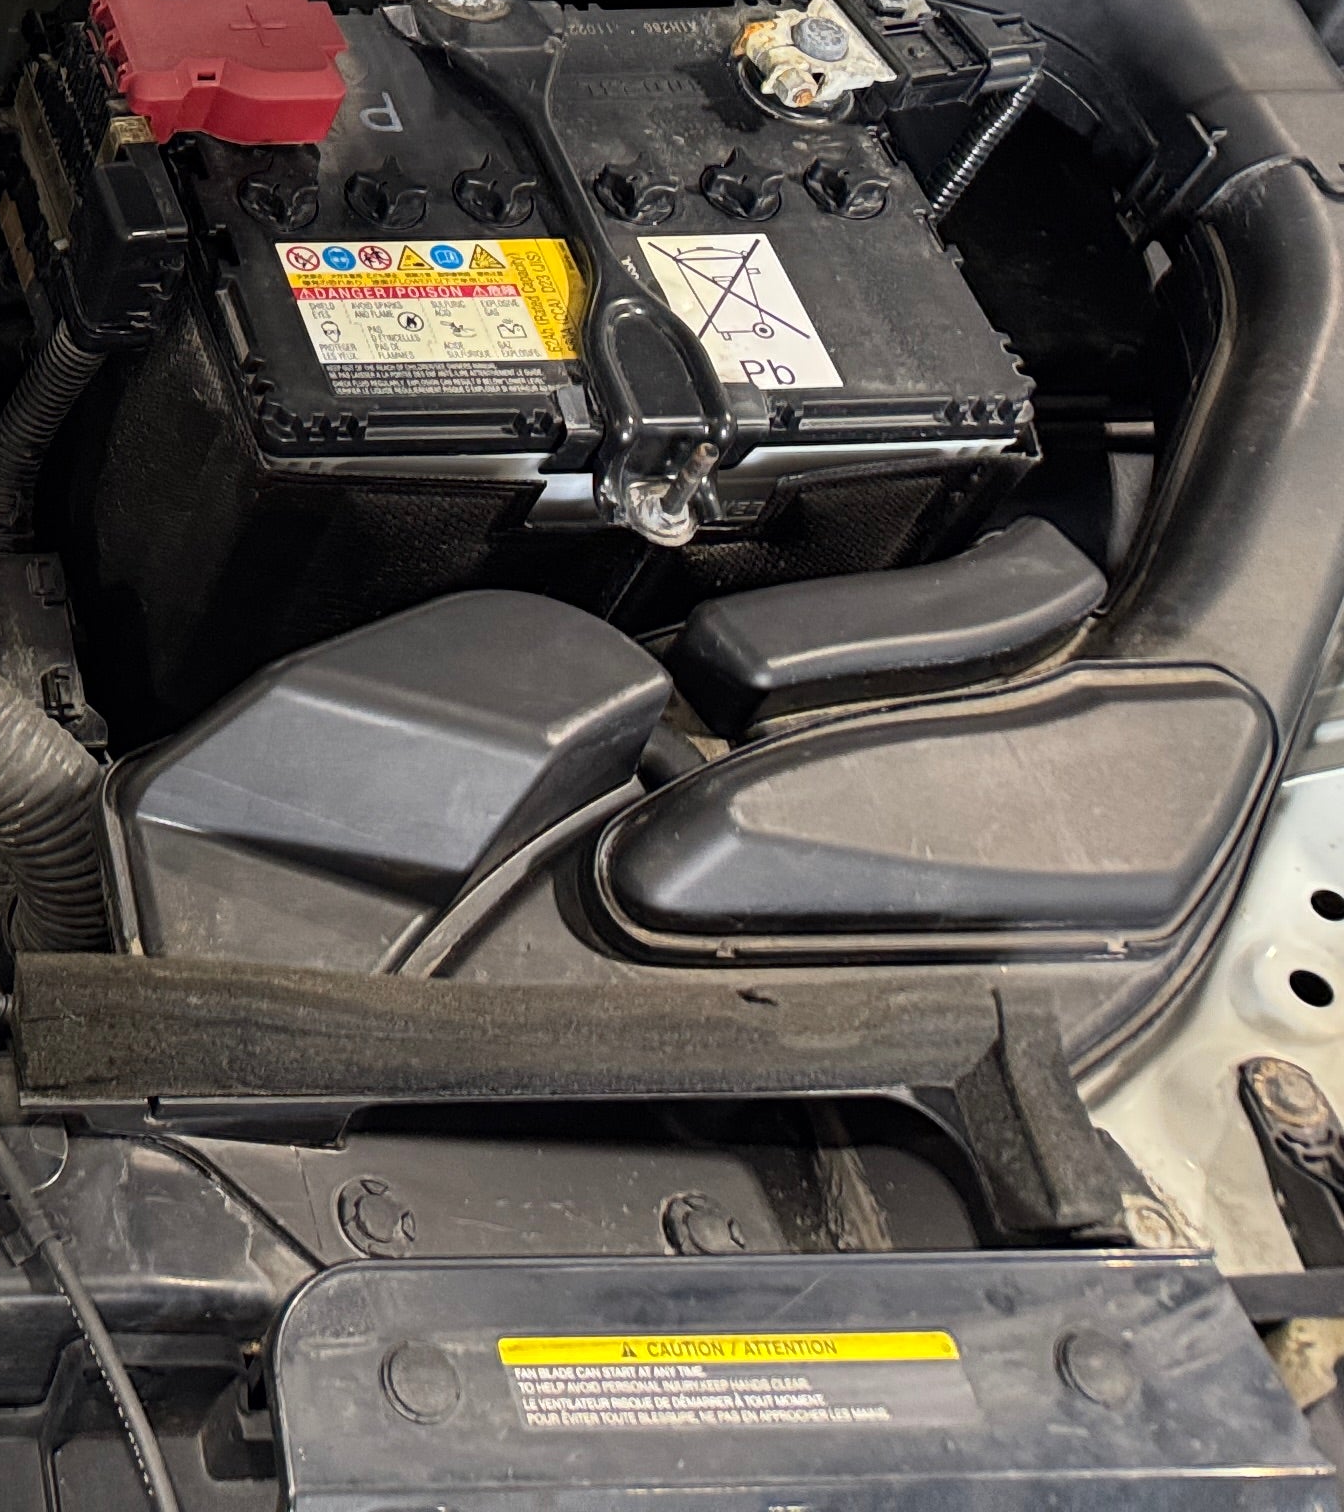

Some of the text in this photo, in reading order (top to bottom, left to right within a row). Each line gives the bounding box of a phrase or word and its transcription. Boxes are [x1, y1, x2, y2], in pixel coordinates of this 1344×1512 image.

[740, 359, 796, 385] Pb
[646, 1340, 724, 1359] CAUTION
[743, 1338, 838, 1356] ATTENTION
[514, 1368, 538, 1379] FAN
[538, 1367, 574, 1379] BLADE
[575, 1366, 602, 1378] CAN
[602, 1366, 636, 1378] START
[638, 1366, 652, 1377] AT
[653, 1365, 676, 1377] ANY
[518, 1382, 535, 1394] TO
[537, 1381, 565, 1393] HELP
[567, 1381, 601, 1393] AVOID
[602, 1380, 661, 1393] PERSONAL
[522, 1398, 538, 1410] LE
[539, 1397, 611, 1410] VENTILATEUR
[655, 1397, 671, 1409] DE
[526, 1413, 560, 1426] POUR
